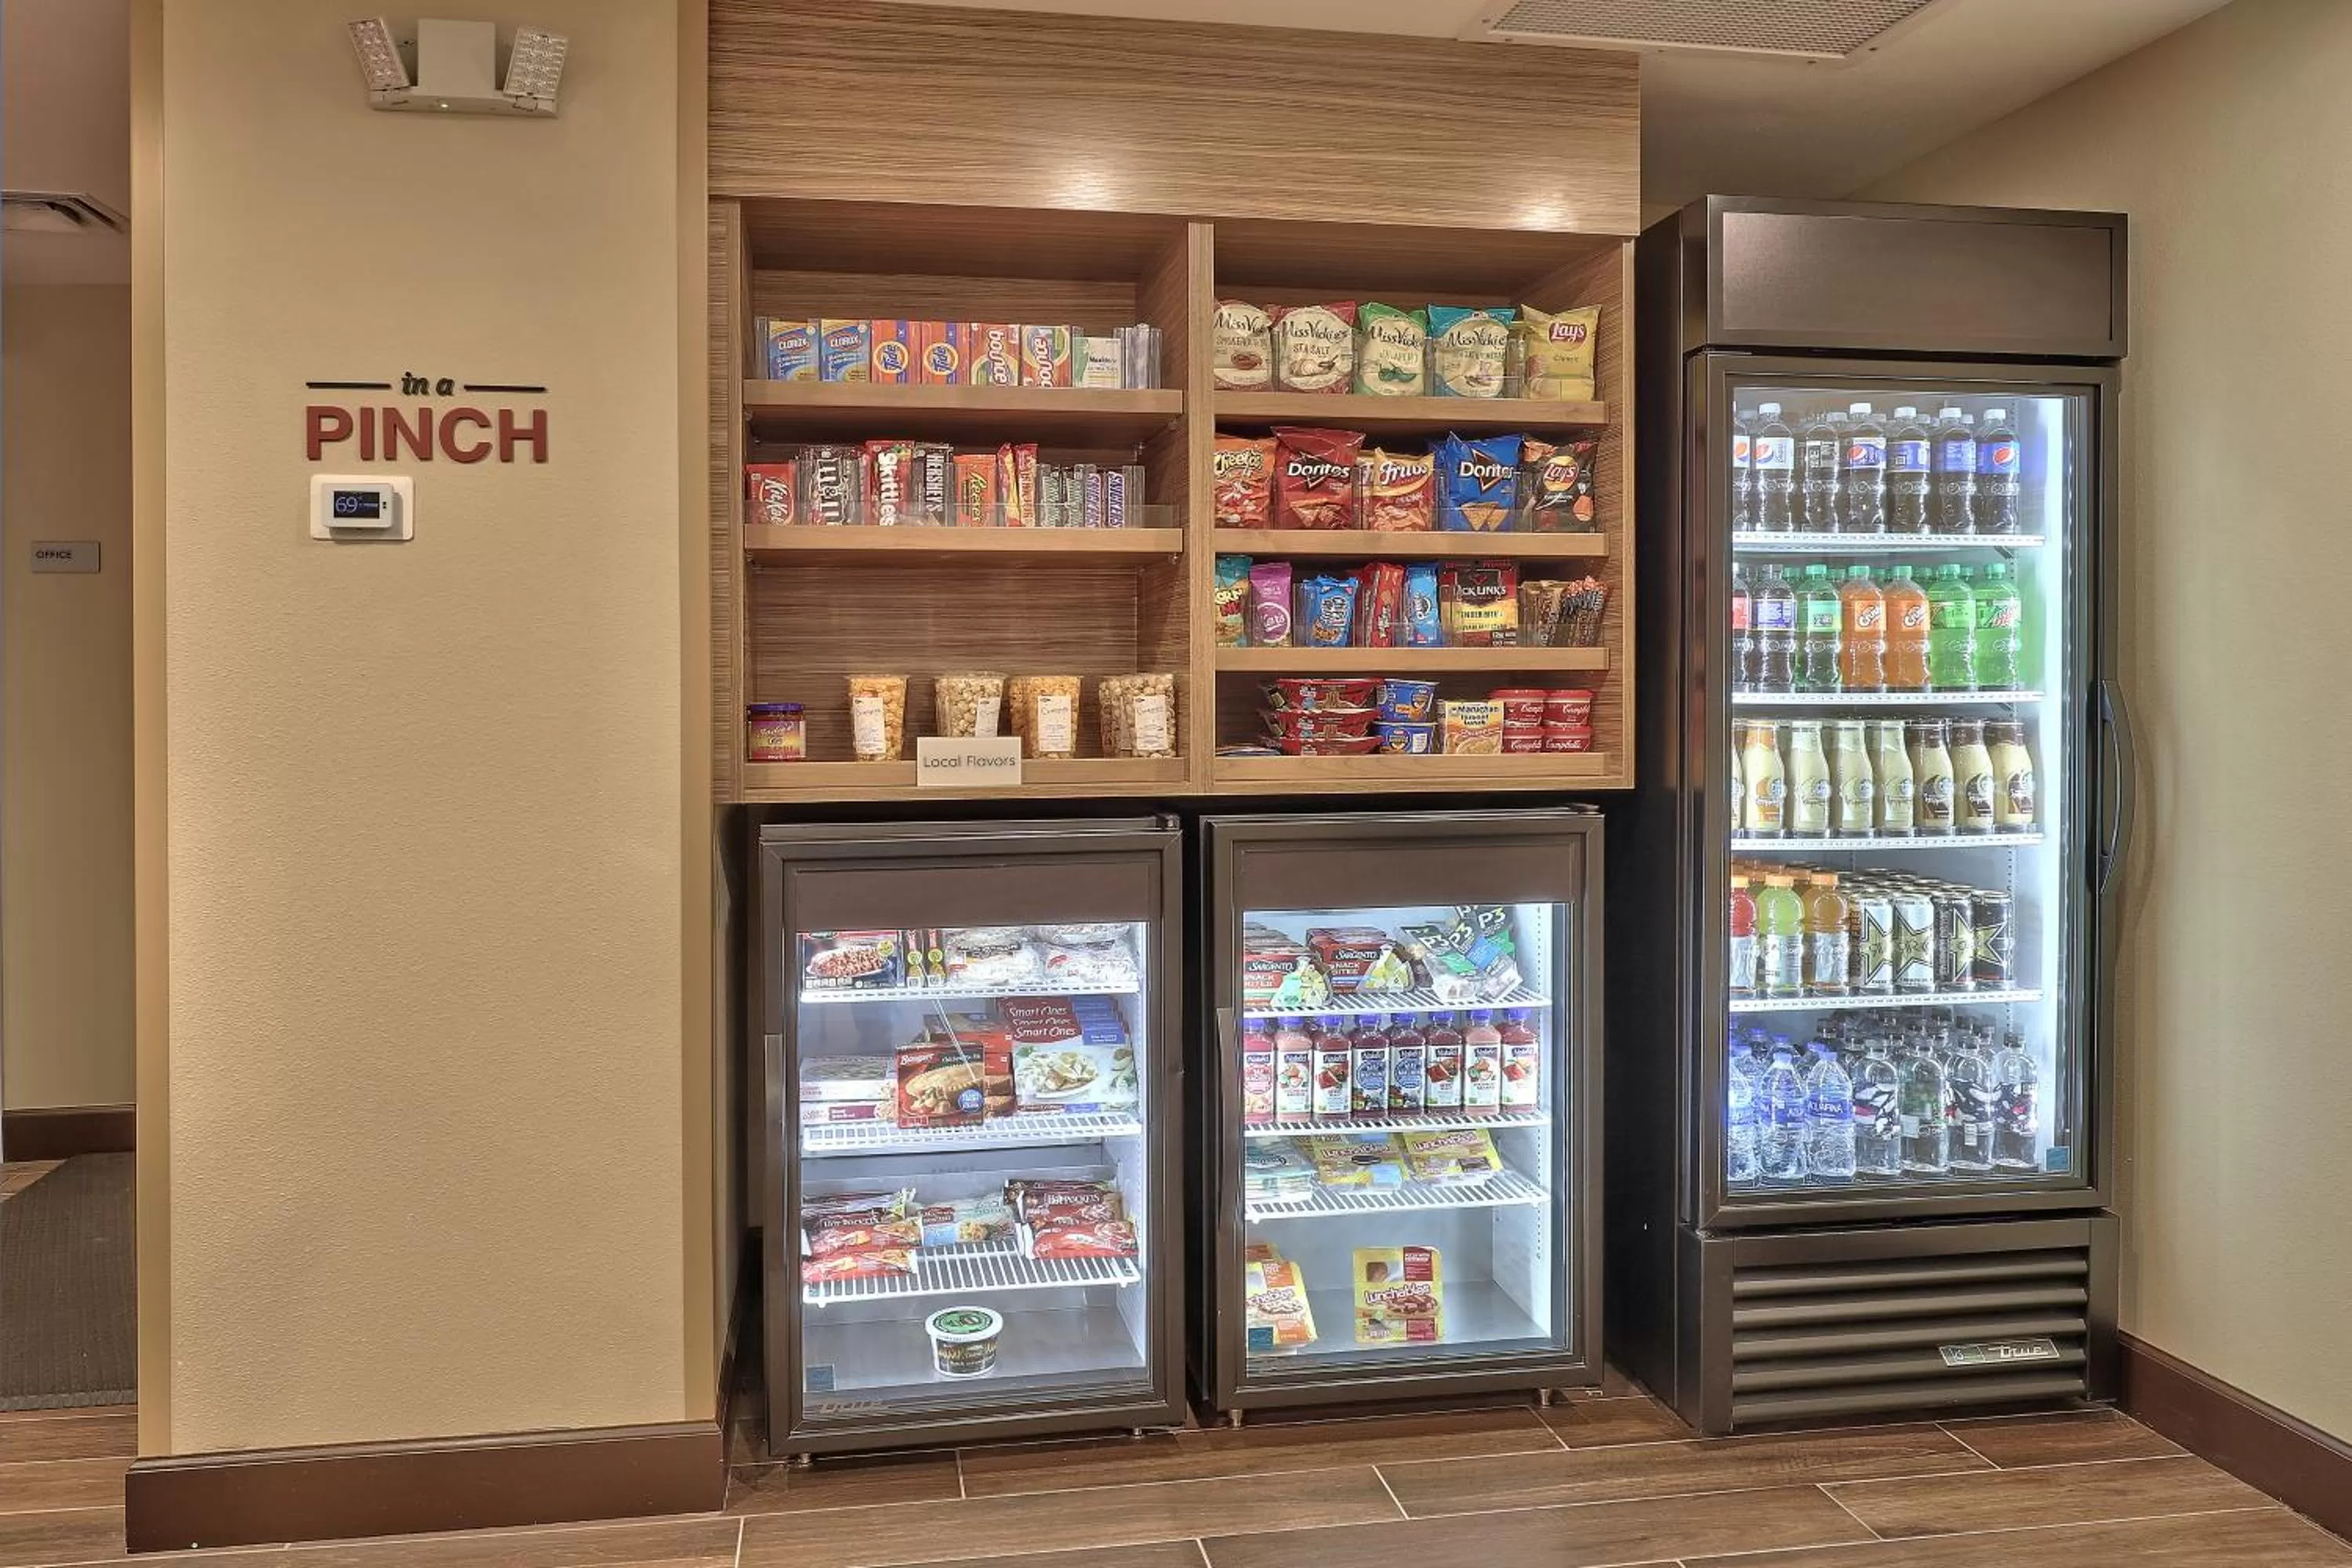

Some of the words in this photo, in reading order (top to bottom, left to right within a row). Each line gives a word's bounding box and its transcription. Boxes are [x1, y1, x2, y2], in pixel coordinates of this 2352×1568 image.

[401, 372, 430, 395] in
[435, 377, 456, 397] a
[306, 405, 548, 463] PINCH
[1288, 463, 1350, 477] Doritos
[1460, 461, 1514, 478] Doritos
[923, 755, 961, 768] Local
[967, 755, 1016, 768] Flavors
[1010, 1006, 1041, 1018] Smart
[1014, 1028, 1047, 1038] Smart
[1049, 1027, 1076, 1036] Ones
